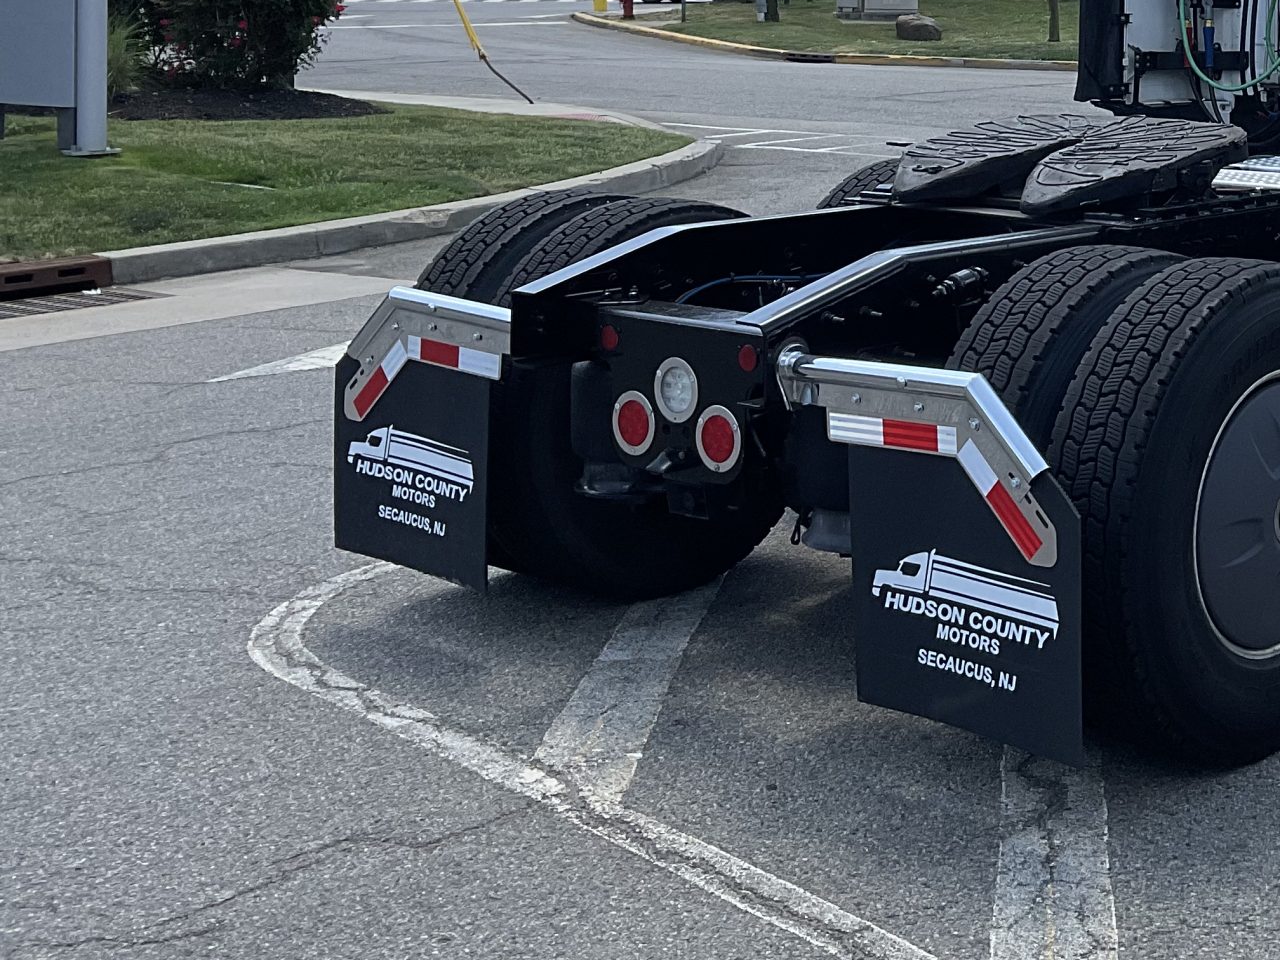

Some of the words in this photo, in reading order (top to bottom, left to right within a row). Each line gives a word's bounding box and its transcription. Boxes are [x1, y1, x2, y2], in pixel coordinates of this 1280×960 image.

[355, 459, 412, 485] HUDSON
[415, 474, 467, 502] COUNTY
[392, 484, 436, 508] MOTORS
[378, 505, 432, 534] SECAUCUS,
[433, 521, 446, 537] NJ
[884, 591, 965, 625] HUDSON
[969, 611, 1050, 649] COUNTY
[936, 624, 1000, 655] MOTORS
[917, 648, 996, 688] SECAUCUS,
[998, 671, 1017, 692] NJ
